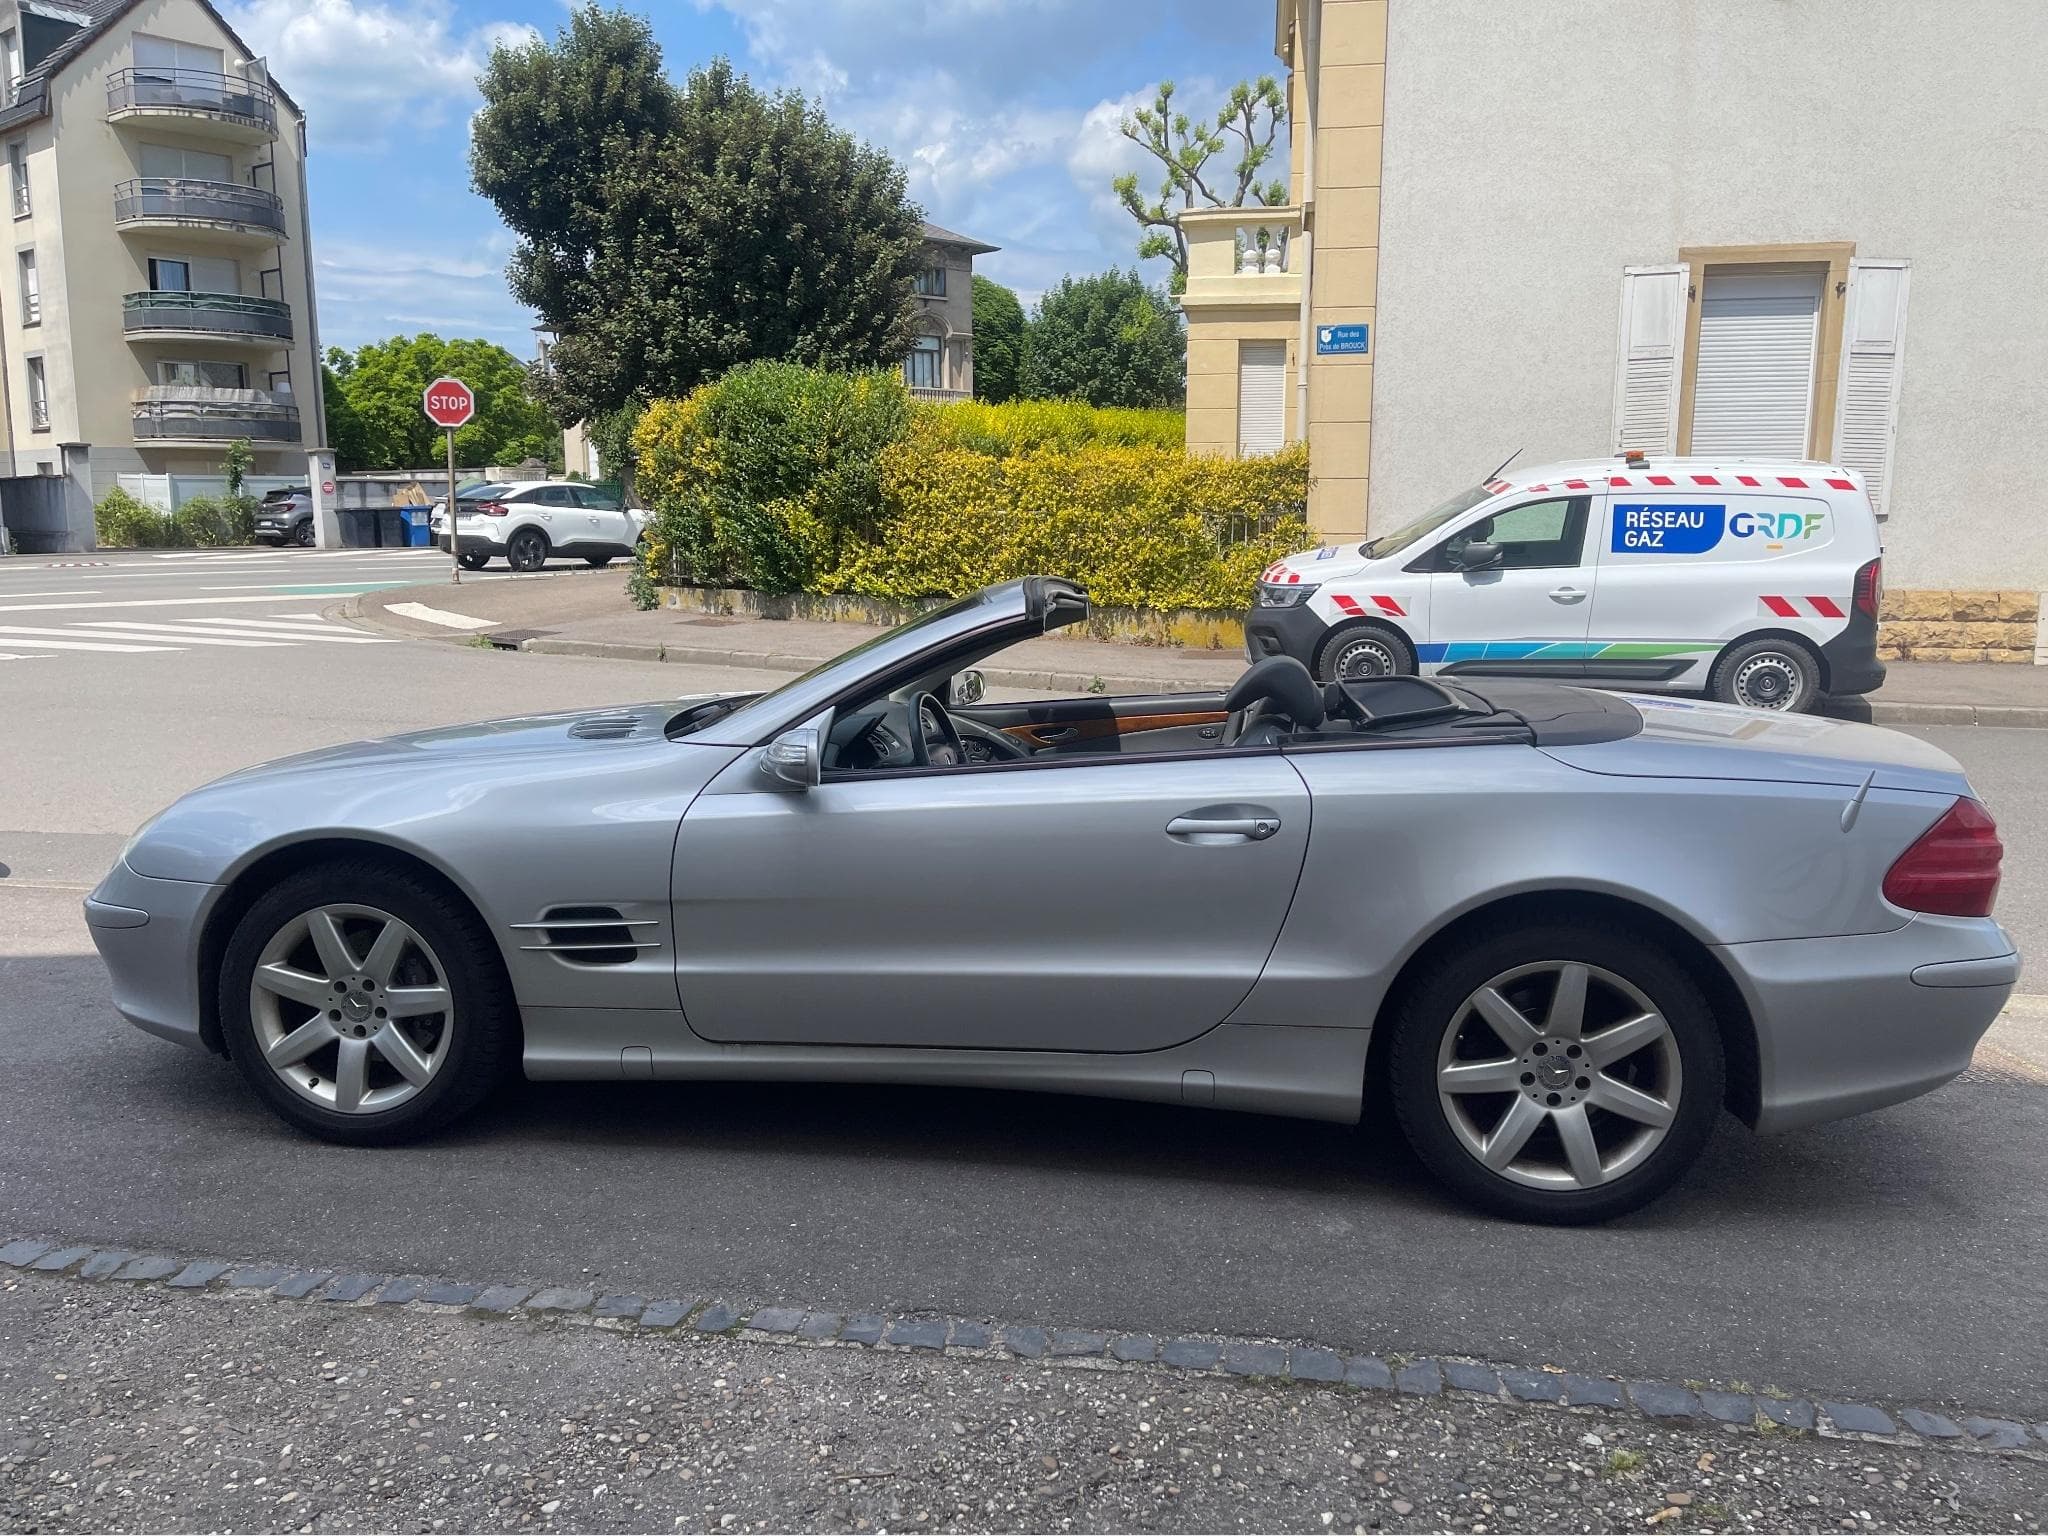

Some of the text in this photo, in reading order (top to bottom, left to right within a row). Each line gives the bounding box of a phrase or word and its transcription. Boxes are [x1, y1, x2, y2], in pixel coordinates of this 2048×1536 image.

[1337, 330, 1360, 338] Rue des
[1340, 342, 1365, 350] BROUCK
[430, 395, 468, 410] STOP
[1625, 507, 1705, 528] RÉSEAU
[1729, 512, 1825, 540] GRDF
[1624, 531, 1664, 547] GAZ
